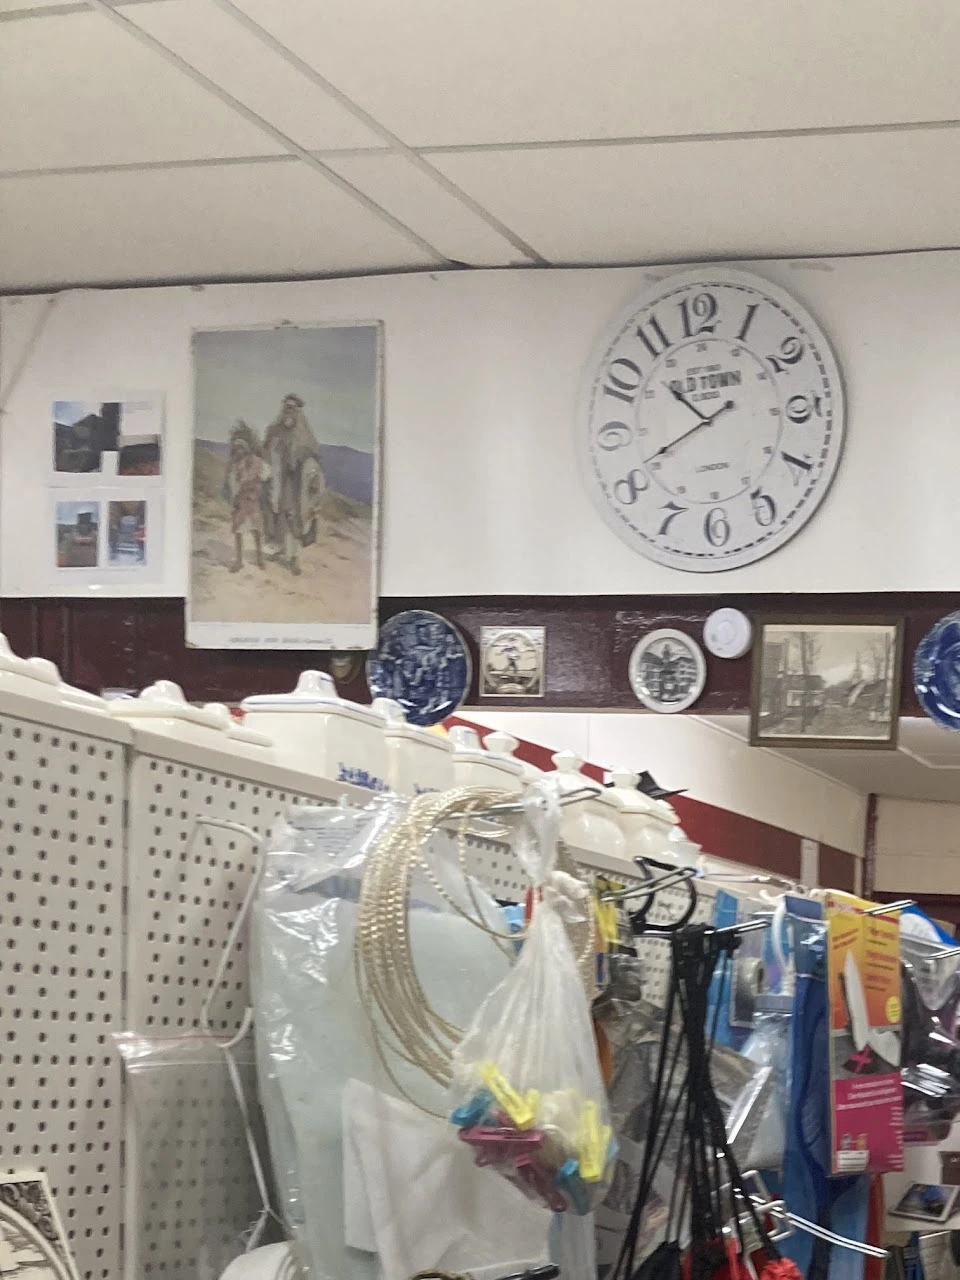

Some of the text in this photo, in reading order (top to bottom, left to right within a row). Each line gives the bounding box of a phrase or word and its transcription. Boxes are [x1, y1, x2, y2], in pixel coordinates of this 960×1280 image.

[636, 312, 675, 360] 11
[676, 292, 722, 340] 12
[735, 303, 760, 343] 1
[765, 335, 805, 375] 2
[602, 357, 644, 405] 10
[785, 389, 824, 425] 3
[597, 420, 632, 452] 9
[613, 467, 649, 506] 8
[781, 450, 814, 488] 4
[656, 500, 690, 536] 7
[751, 486, 777, 527] 5
[703, 507, 731, 548] 6
